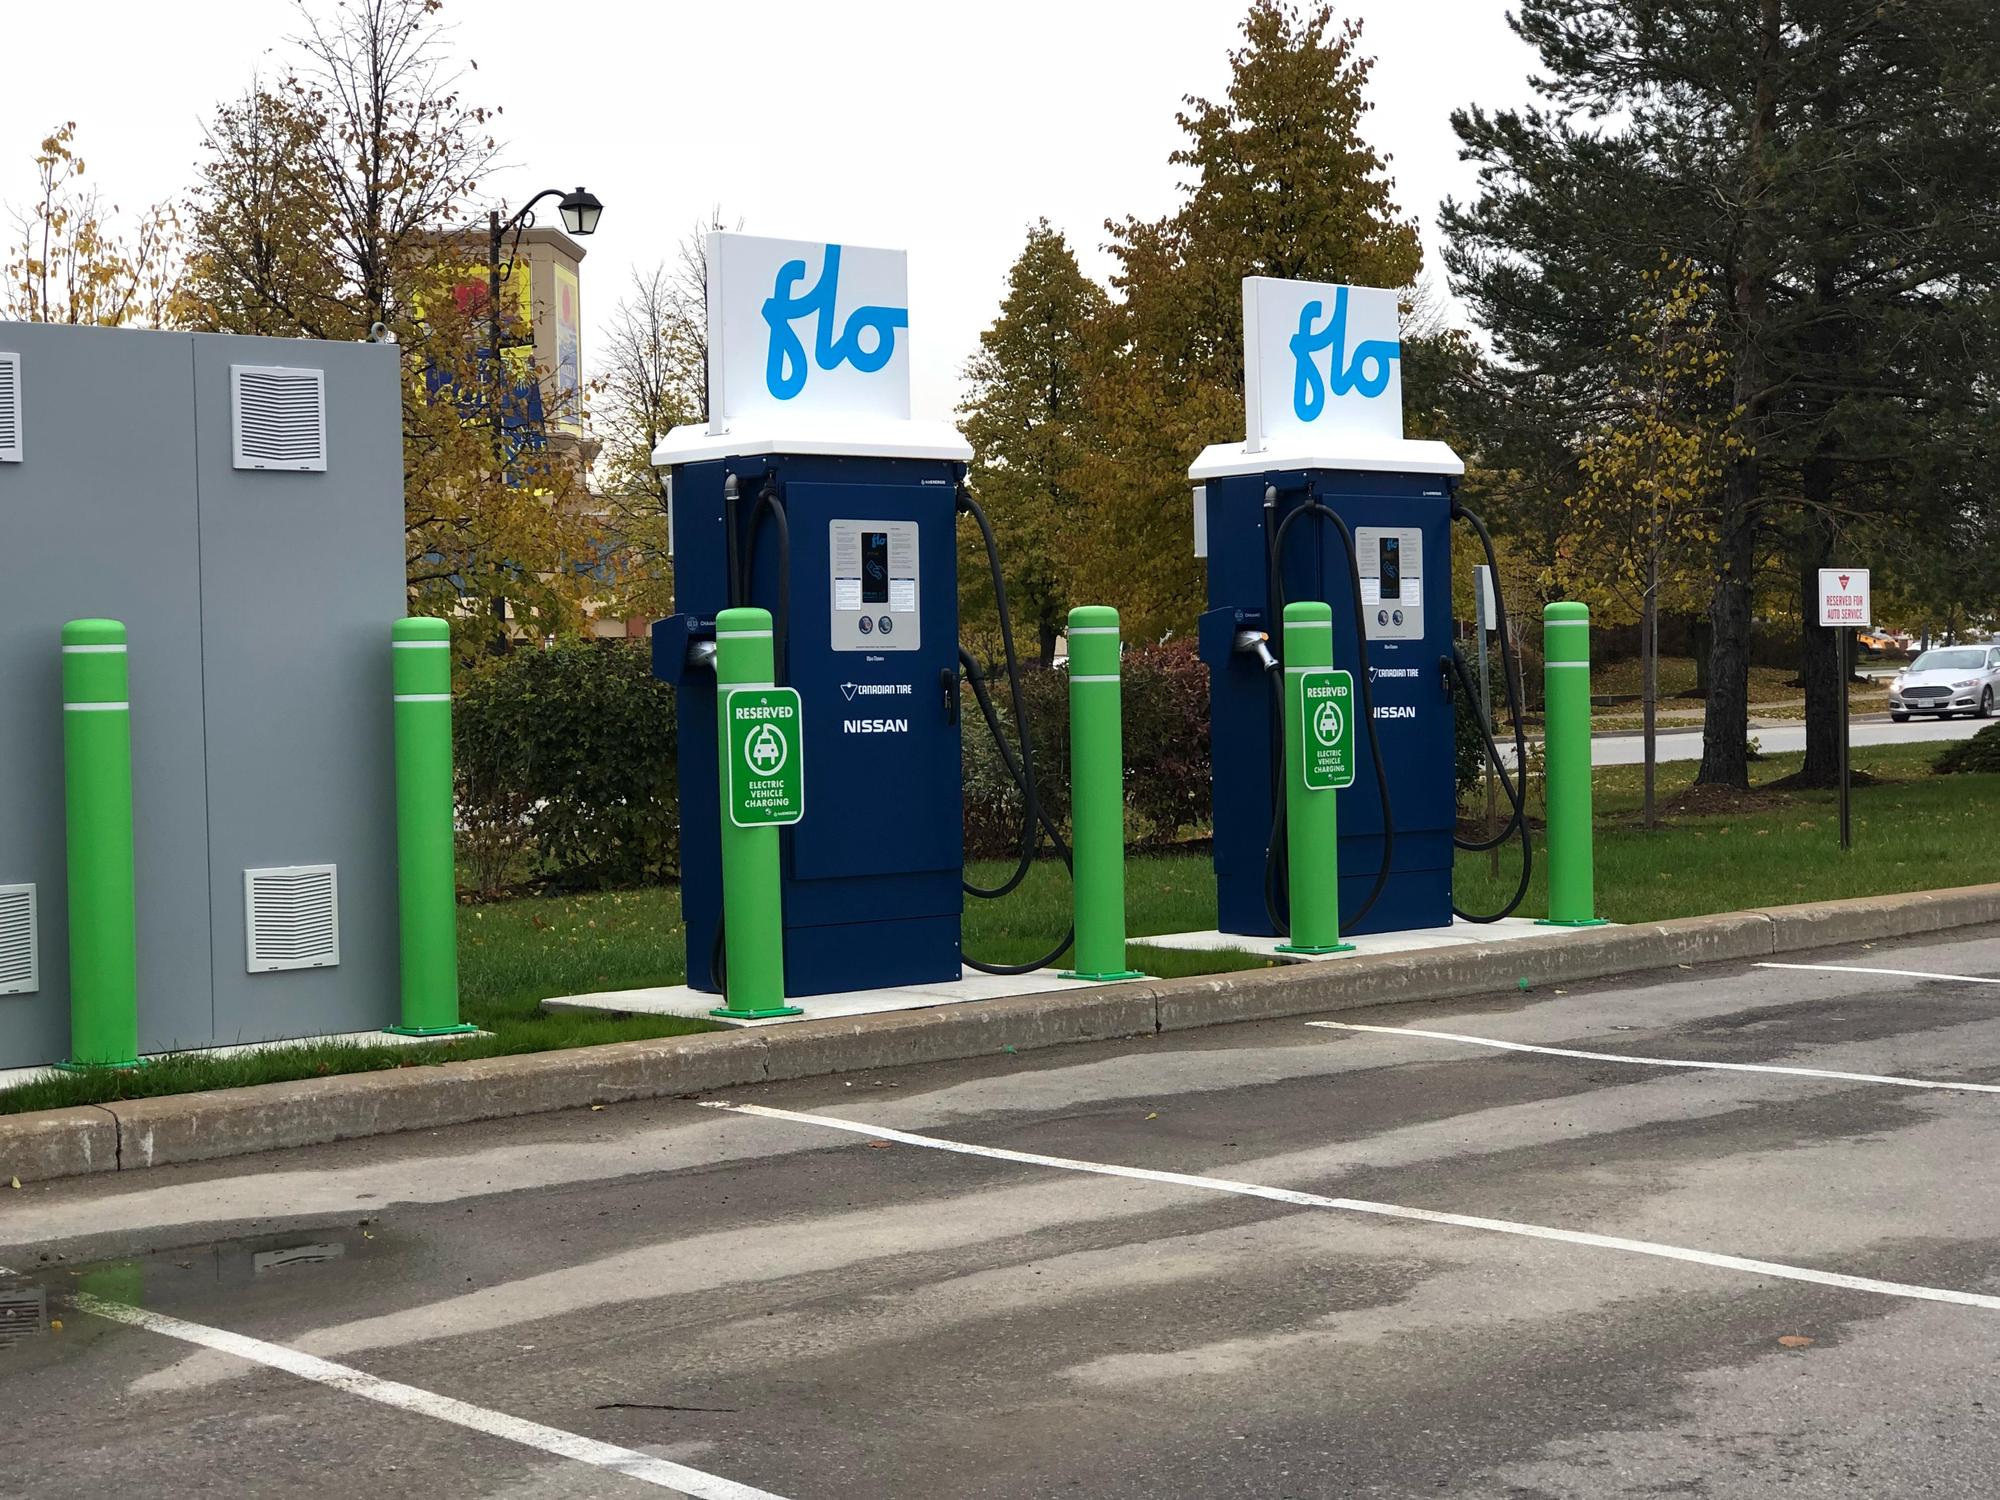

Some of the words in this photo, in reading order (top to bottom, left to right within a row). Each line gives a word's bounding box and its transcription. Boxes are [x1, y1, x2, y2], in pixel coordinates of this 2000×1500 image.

[761, 243, 908, 401] flo
[1289, 286, 1401, 422] flo
[871, 534, 887, 548] flo
[1826, 595, 1852, 606] RESERVED
[1853, 595, 1864, 606] FOR
[1827, 608, 1841, 619] AUTO
[1841, 608, 1863, 619] SERVICE
[1378, 668, 1406, 678] CANADIAN
[1406, 668, 1419, 677] TIRE
[858, 684, 896, 695] CANADIAN
[895, 684, 912, 695] TIRE
[1307, 686, 1348, 698] RESERVED
[735, 706, 794, 720] RESERVED
[843, 719, 908, 733] NISSAN
[1317, 749, 1342, 758] ELECTRIC
[1318, 757, 1341, 765] VEHICLE
[1313, 765, 1345, 774] CHARGING
[748, 779, 785, 789] ELECTRIC
[750, 789, 783, 798] VEHICLE
[744, 797, 790, 808] CHARGING
